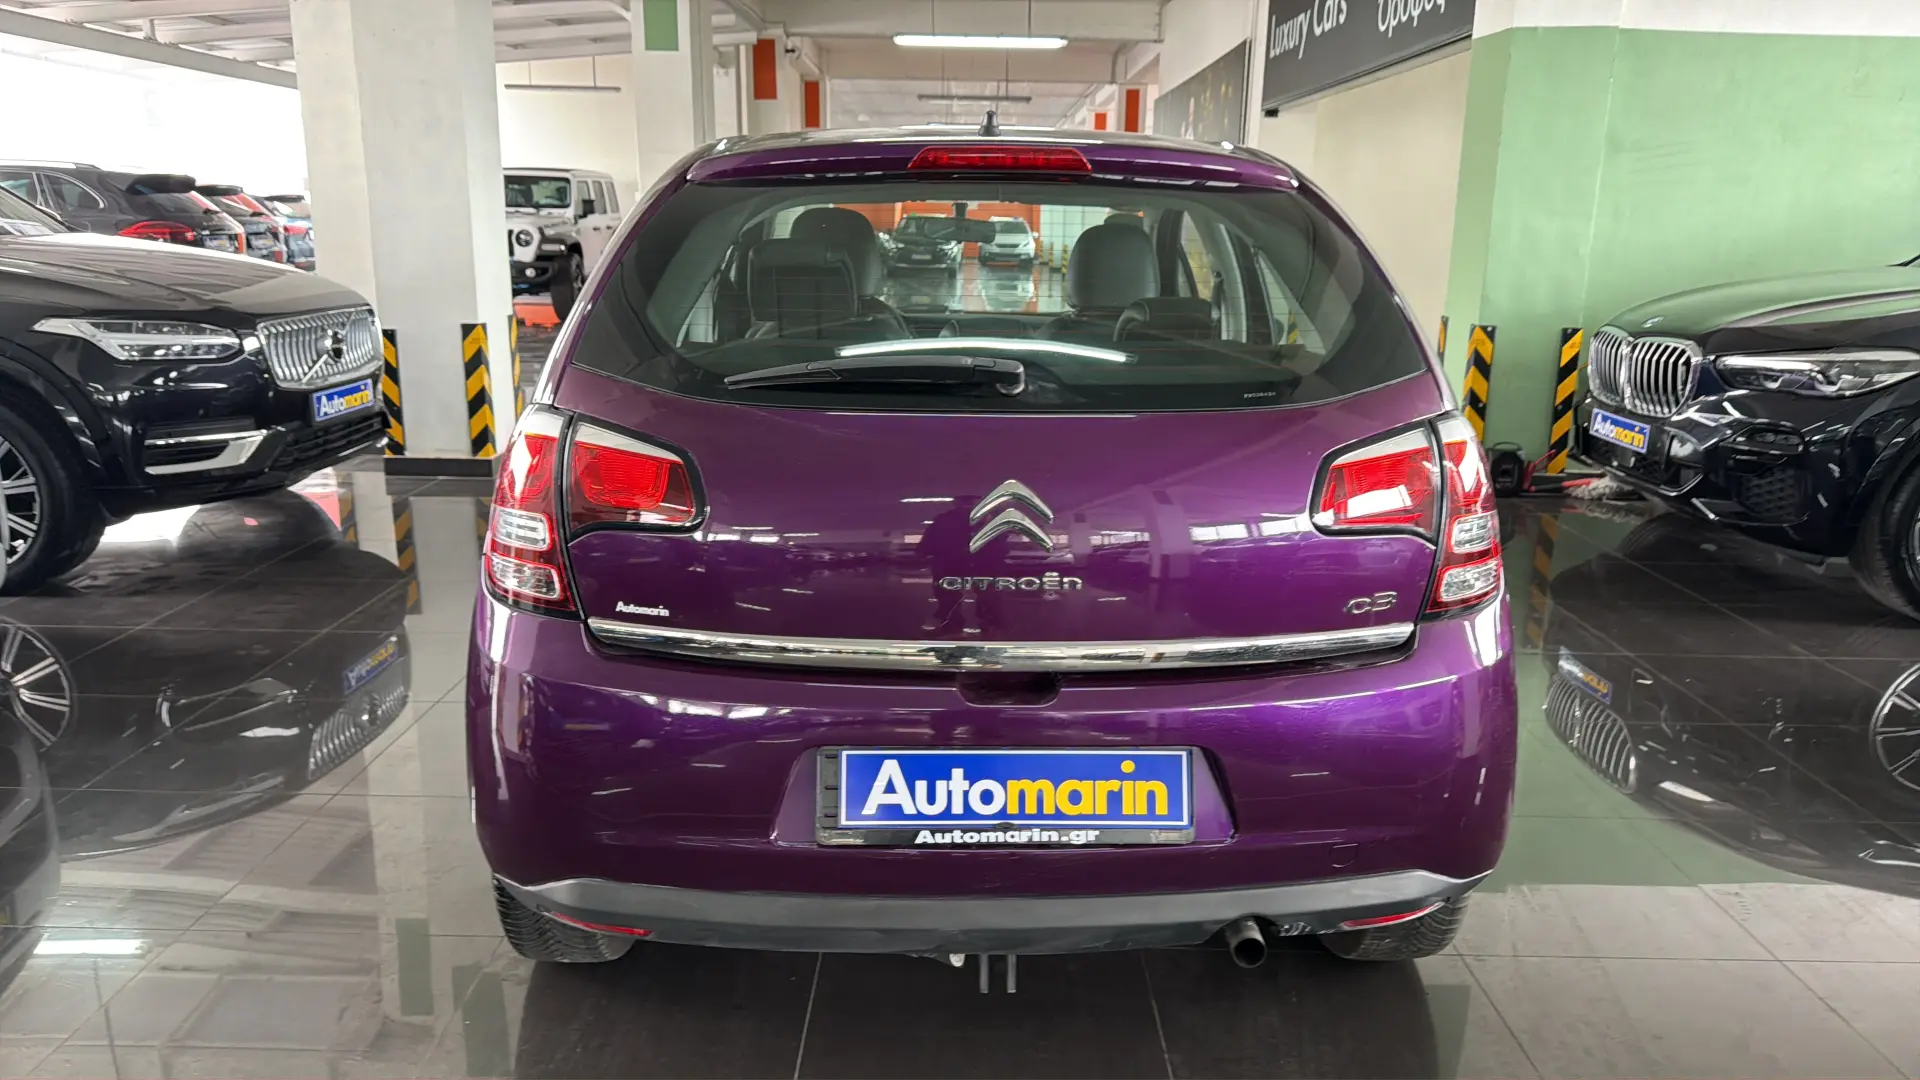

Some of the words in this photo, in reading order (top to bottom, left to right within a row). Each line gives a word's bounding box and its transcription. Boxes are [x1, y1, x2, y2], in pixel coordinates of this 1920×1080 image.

[1269, 8, 1311, 59] Luxury
[1312, 0, 1347, 36] Cars
[320, 384, 370, 417] Automarin
[1593, 413, 1645, 448] Automarin
[615, 601, 670, 616] Automarin
[861, 759, 1168, 816] Automarin
[914, 828, 1100, 845] Automarin.gr
